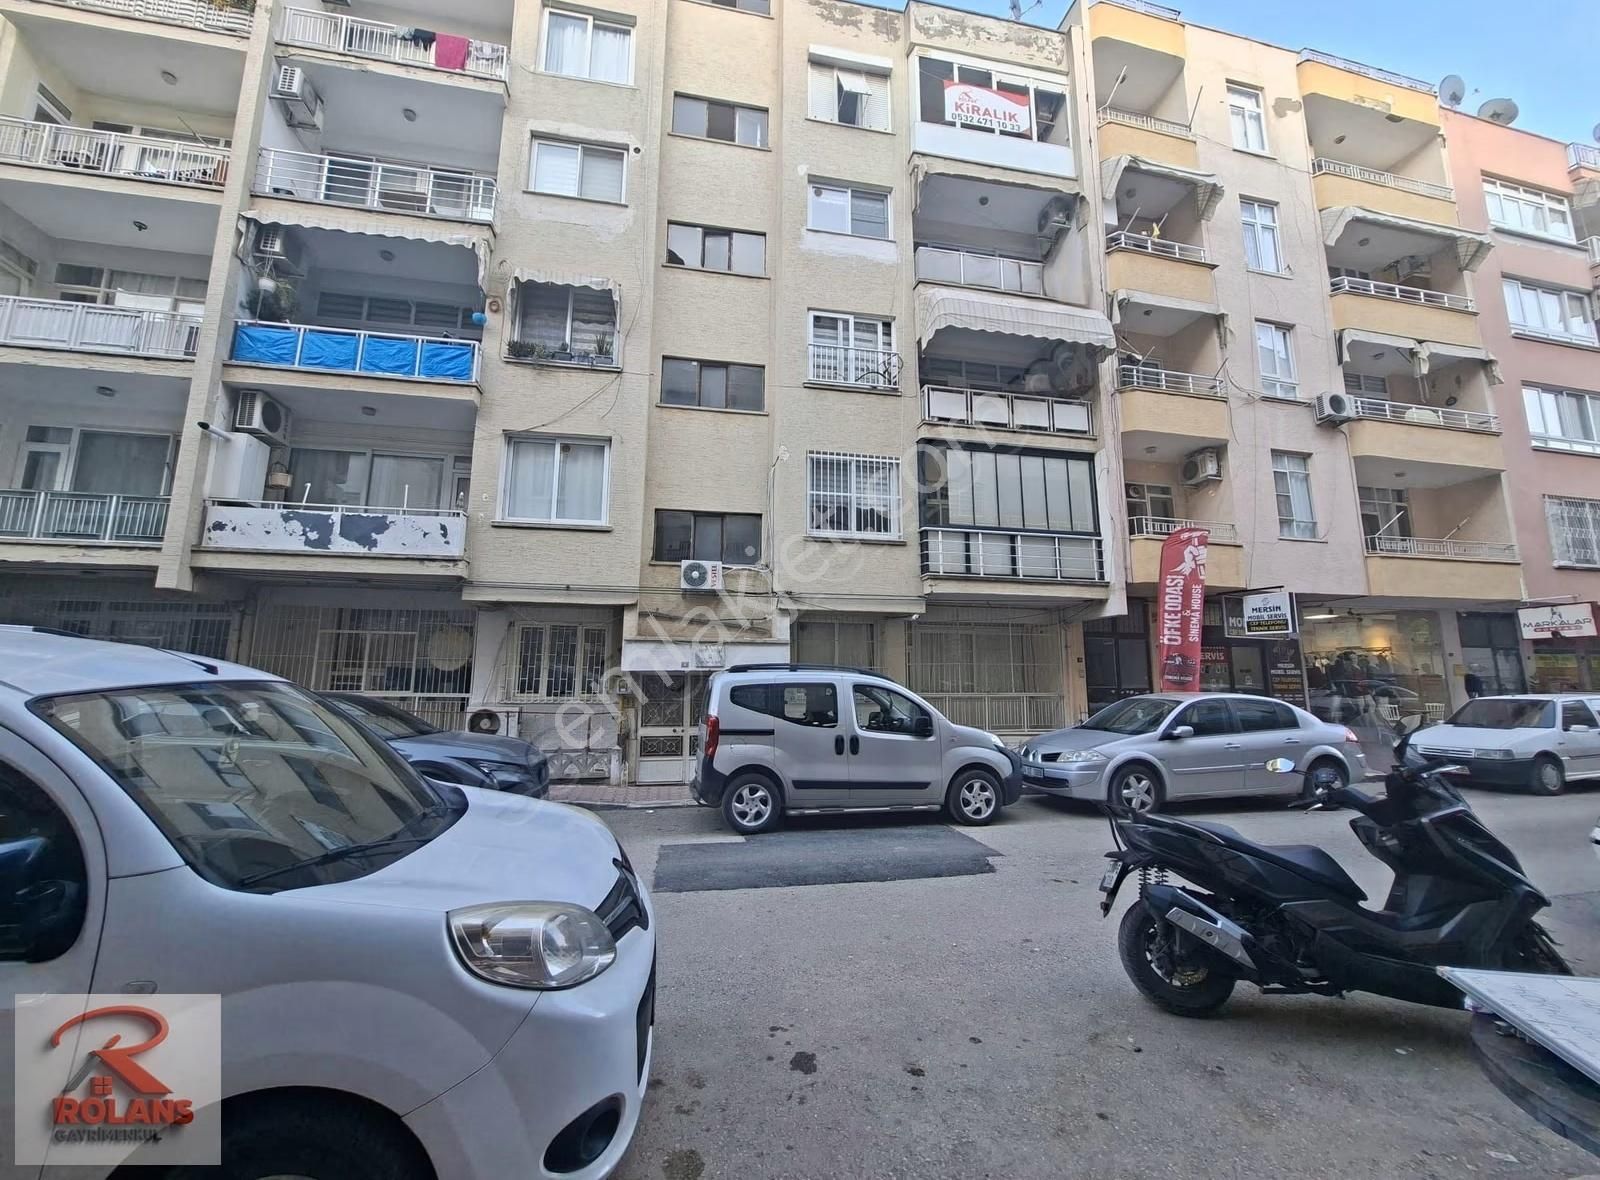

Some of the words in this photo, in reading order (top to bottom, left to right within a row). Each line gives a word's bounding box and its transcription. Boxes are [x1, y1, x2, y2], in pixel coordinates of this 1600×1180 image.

[951, 112, 975, 124] 0532
[977, 117, 993, 127] 471
[996, 120, 1008, 129] 10
[1009, 123, 1021, 132] 33
[1164, 574, 1185, 611] ODASI
[1191, 583, 1202, 610] HOUSE
[1251, 604, 1282, 614] MERSİN
[1160, 612, 1182, 646] ÖFKE
[1522, 617, 1593, 628] MARKALAR
[1200, 650, 1224, 661] ERVİS
